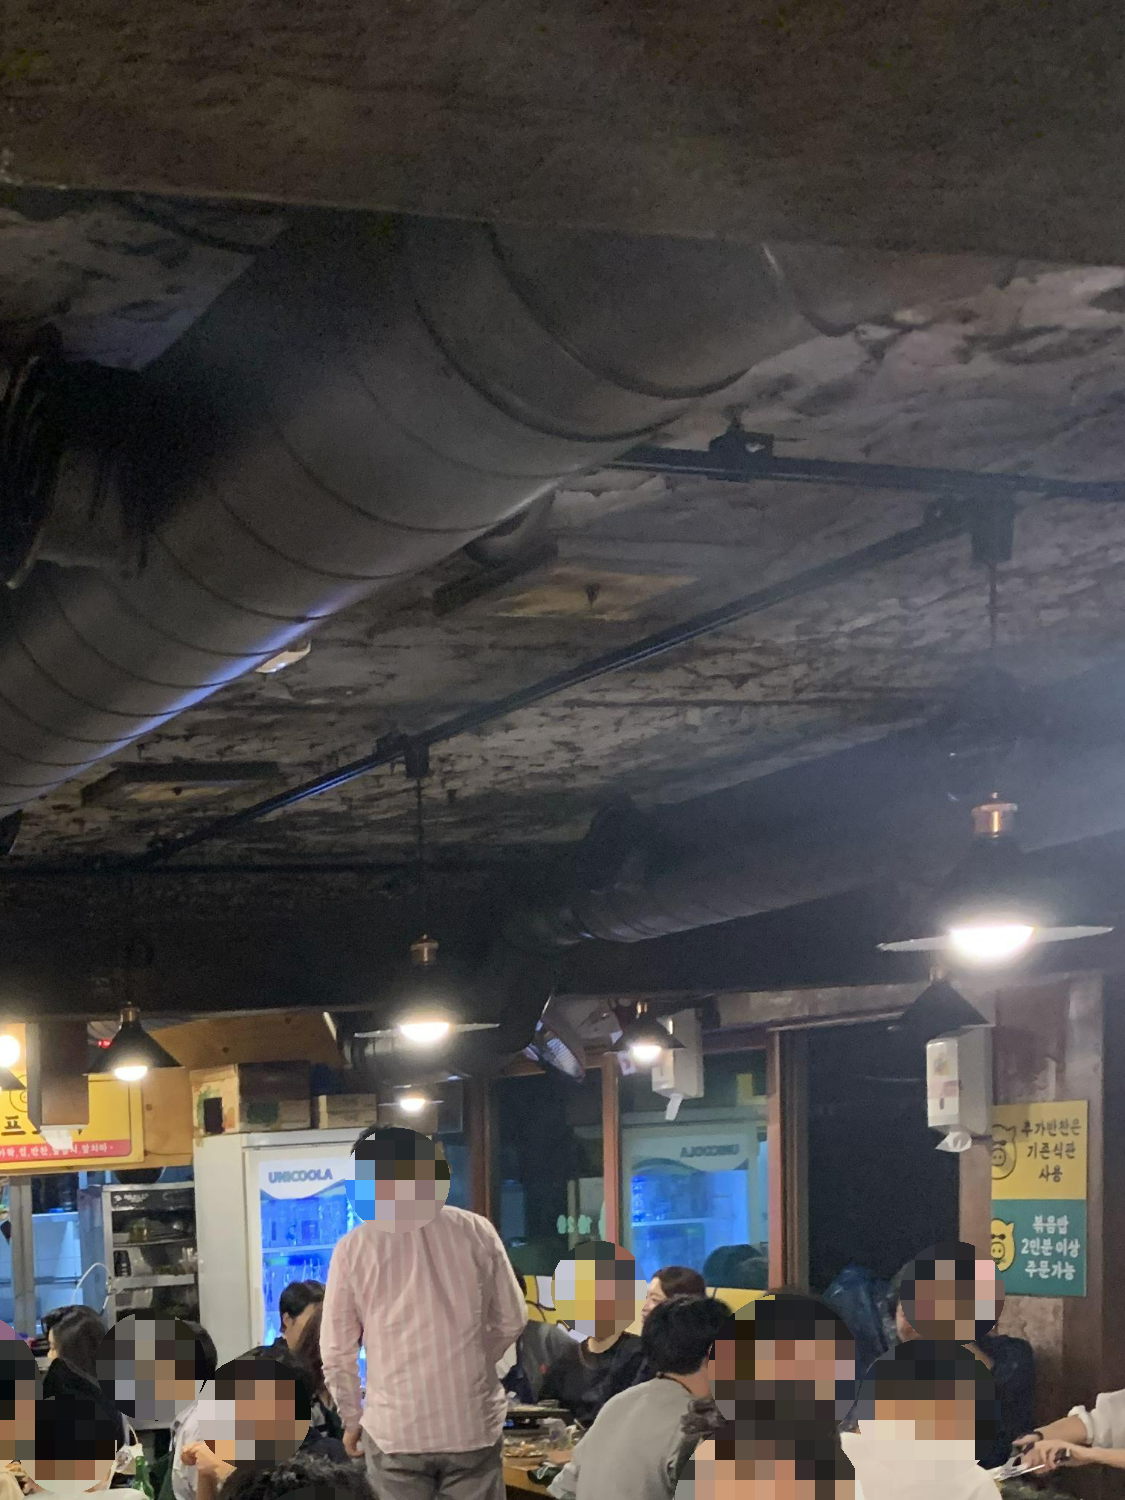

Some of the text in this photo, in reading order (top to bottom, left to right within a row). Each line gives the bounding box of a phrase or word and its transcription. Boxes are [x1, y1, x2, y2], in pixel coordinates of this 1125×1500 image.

[268, 1168, 333, 1184] UNICOOLA
[1038, 1164, 1063, 1183] 사용
[1021, 1238, 1080, 1258] 2인분 이상
[1025, 1260, 1076, 1280] 주문가능
